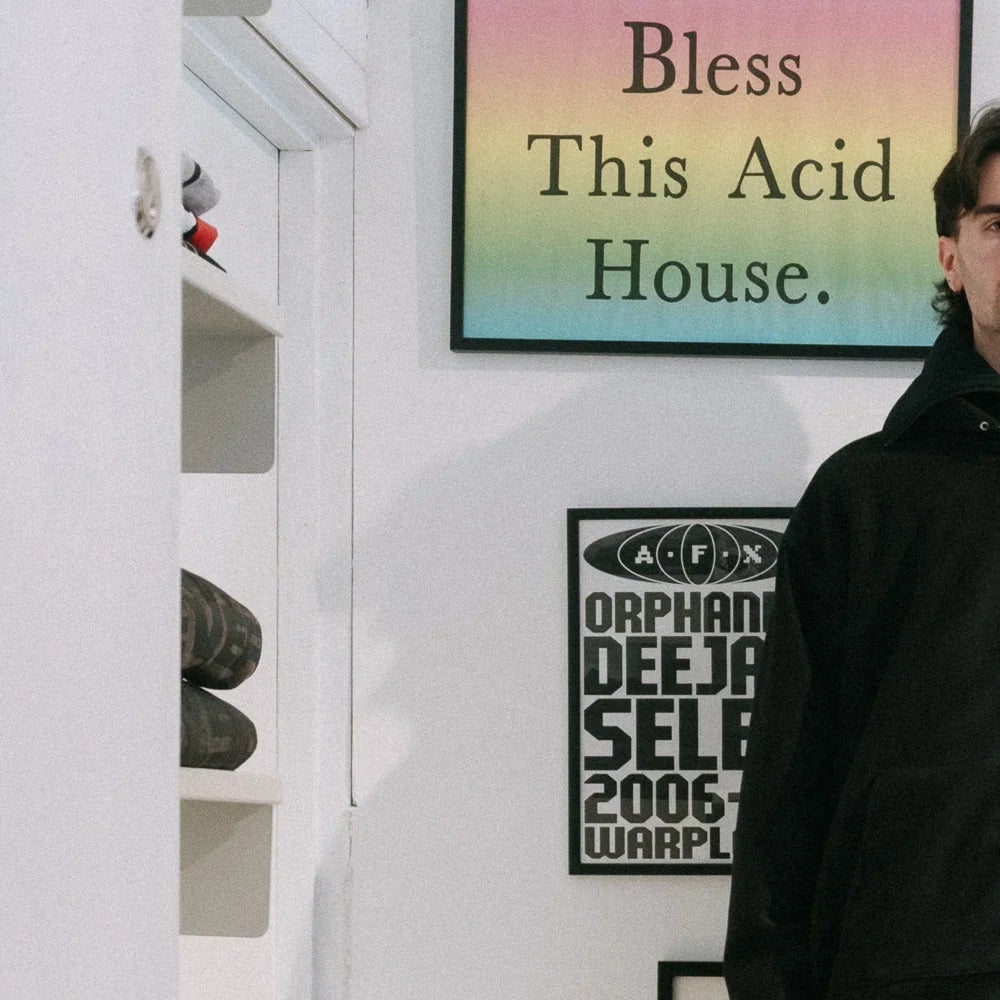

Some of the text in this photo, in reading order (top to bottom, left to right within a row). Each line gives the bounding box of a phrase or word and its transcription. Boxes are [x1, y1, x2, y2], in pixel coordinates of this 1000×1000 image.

[622, 20, 803, 97] Bless
[527, 133, 896, 203] This Acid
[585, 237, 831, 306] House.
